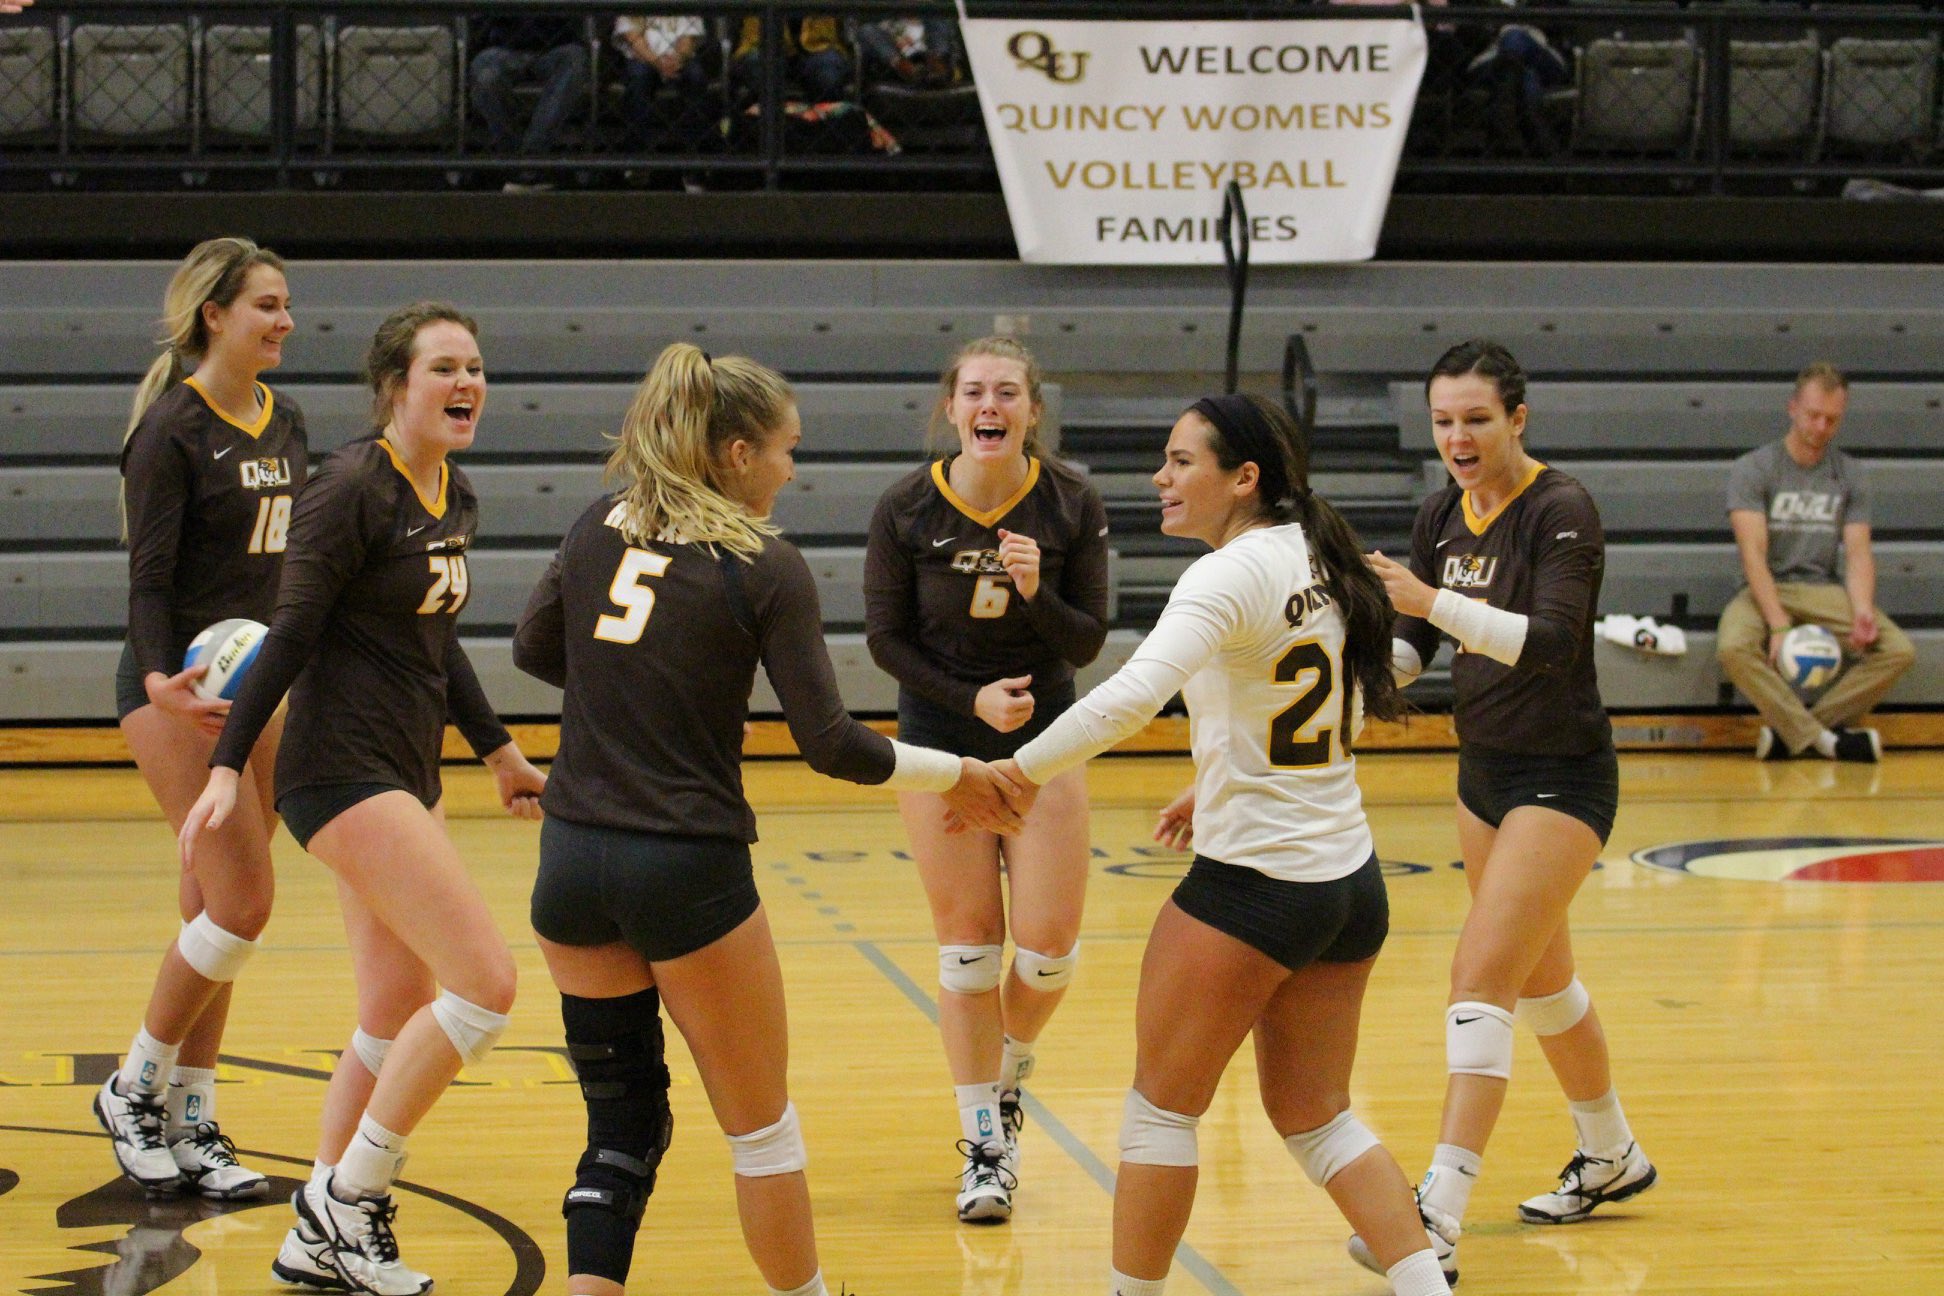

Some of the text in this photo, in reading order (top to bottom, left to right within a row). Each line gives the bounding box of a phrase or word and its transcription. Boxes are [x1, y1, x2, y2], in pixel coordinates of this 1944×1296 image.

[1140, 44, 1391, 75] WELCOME
[997, 102, 1392, 134] QUINCY WOMENS
[1045, 160, 1347, 190] VOLLEYBALL
[247, 495, 293, 553] 18
[593, 546, 673, 645] 5
[969, 574, 1013, 619] 6
